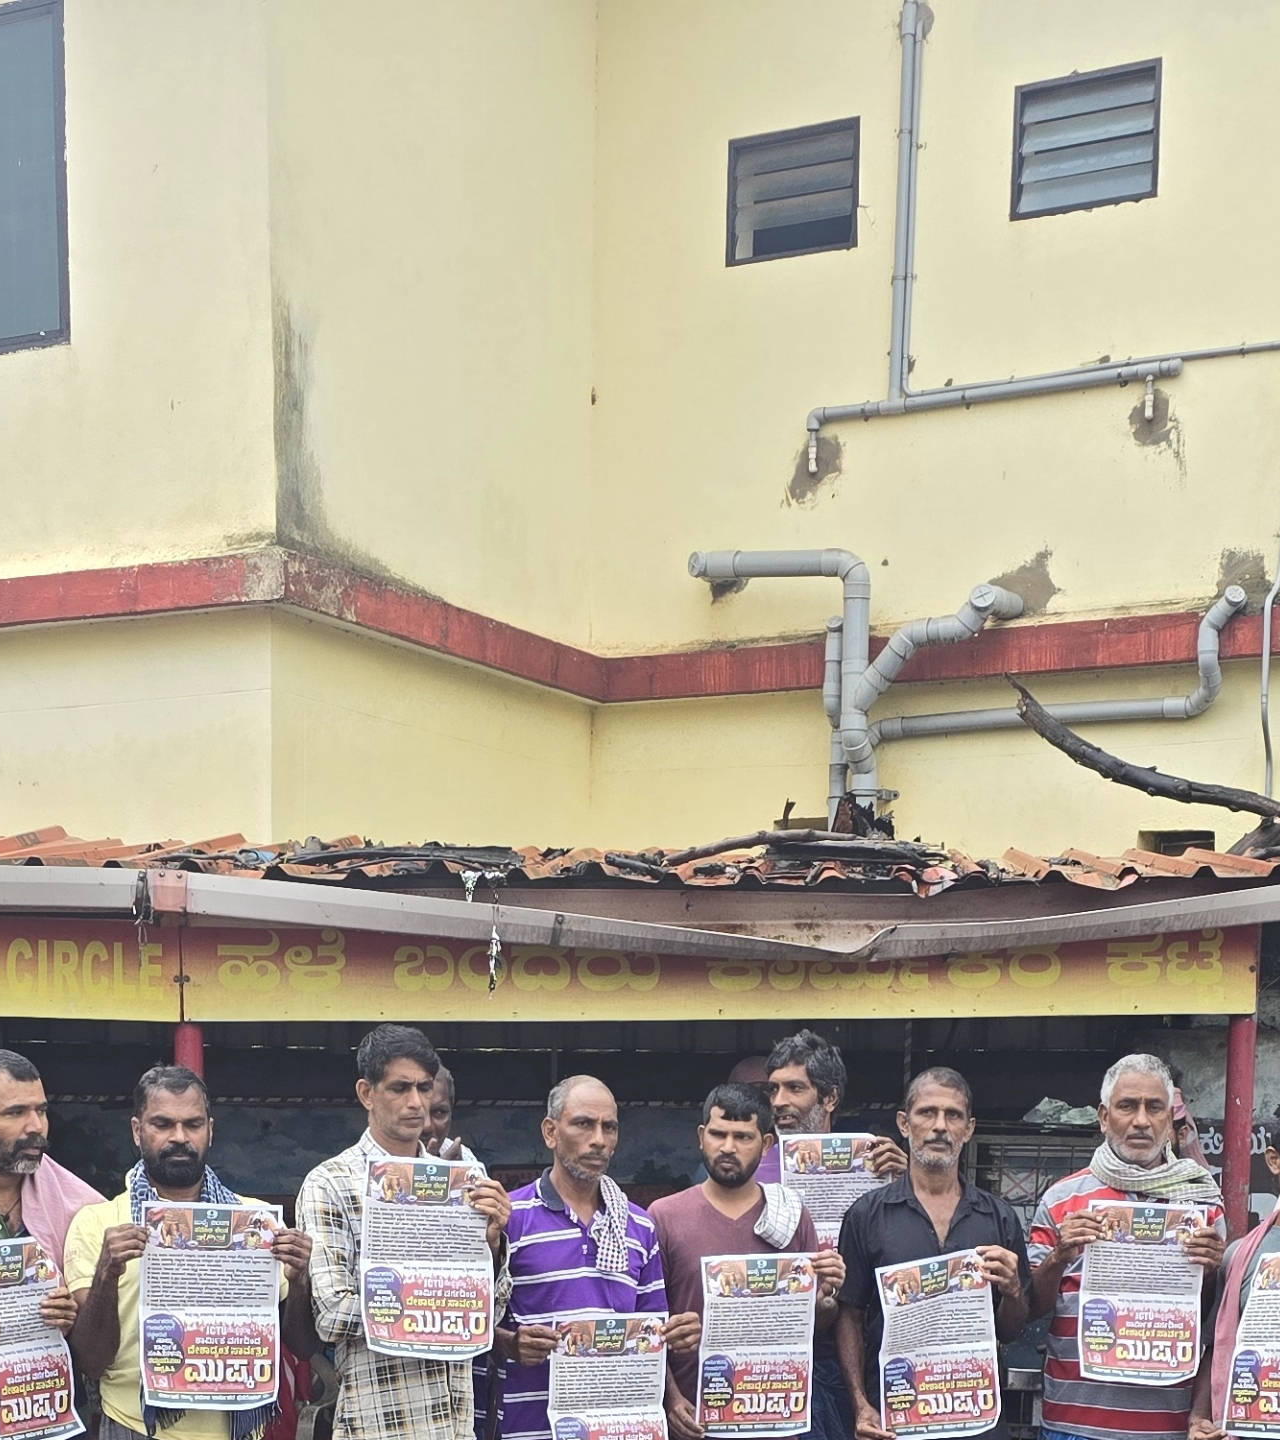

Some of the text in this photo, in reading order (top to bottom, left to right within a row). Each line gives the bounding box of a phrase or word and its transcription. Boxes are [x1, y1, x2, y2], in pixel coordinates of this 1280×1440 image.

[6, 938, 163, 999] CIRCLE
[217, 928, 347, 991] ಹಳೆ
[1116, 1339, 1193, 1368] ಮುಷ್ಕರ
[917, 1388, 993, 1416] ಮುಷ್ಕರ
